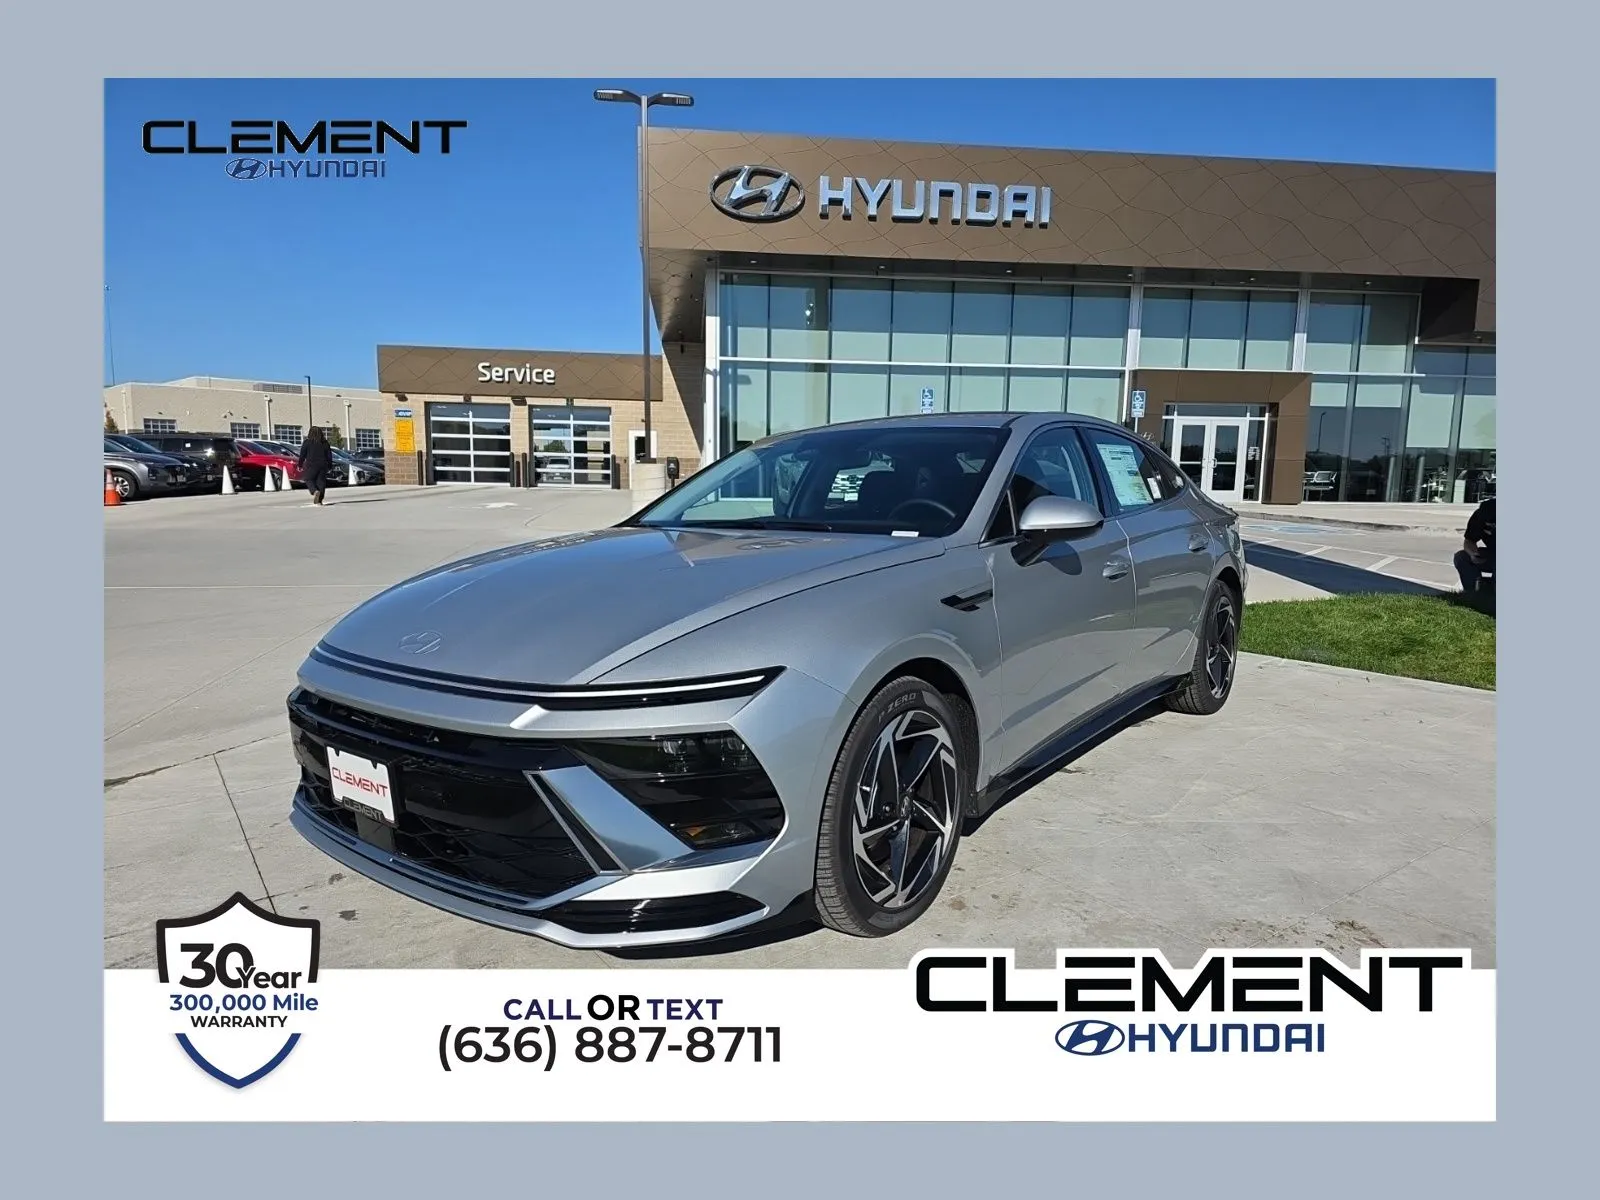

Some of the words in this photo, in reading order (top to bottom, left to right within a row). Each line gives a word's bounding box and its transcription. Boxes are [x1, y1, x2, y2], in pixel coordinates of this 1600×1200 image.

[818, 175, 1051, 229] HYUNDAI
[477, 362, 556, 384] Service
[332, 767, 388, 797] CLEMENT
